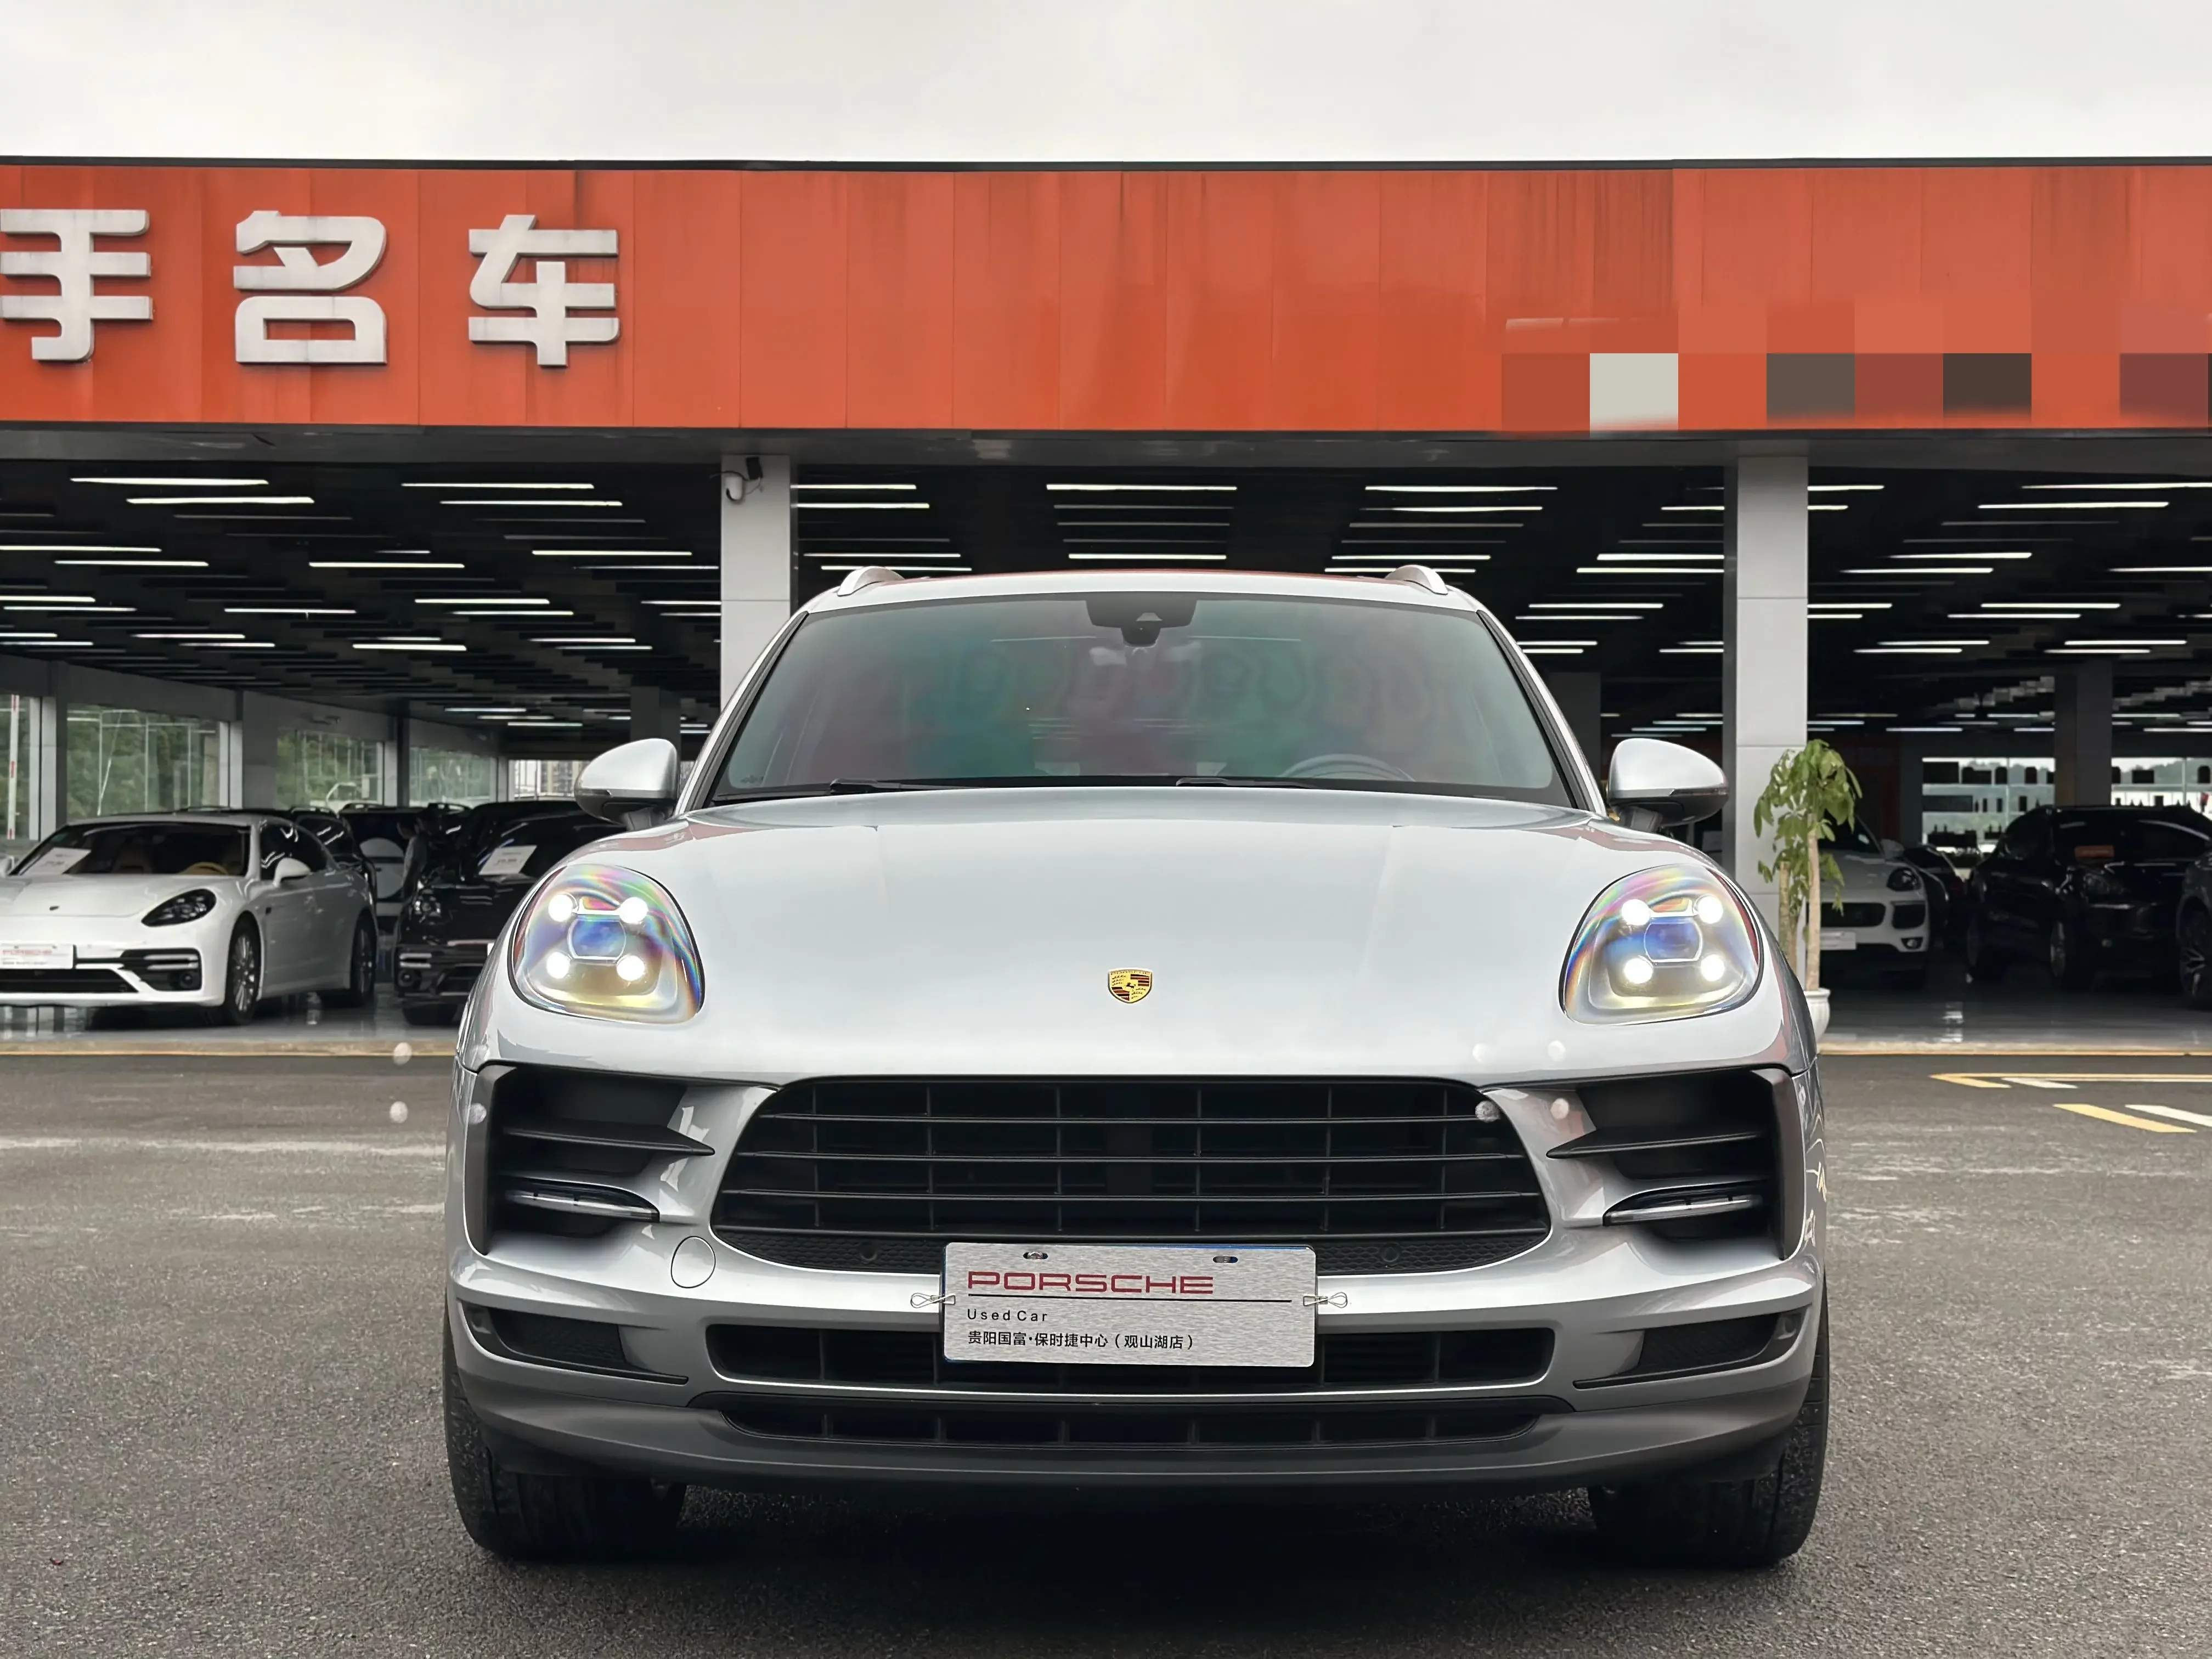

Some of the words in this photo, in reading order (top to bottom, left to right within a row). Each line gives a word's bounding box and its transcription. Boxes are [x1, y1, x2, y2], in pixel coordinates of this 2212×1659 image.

[0, 209, 620, 367] 手名车
[968, 1271, 1214, 1294] PORSCHE
[967, 1308, 1011, 1321] Used
[1017, 1310, 1048, 1322] Car
